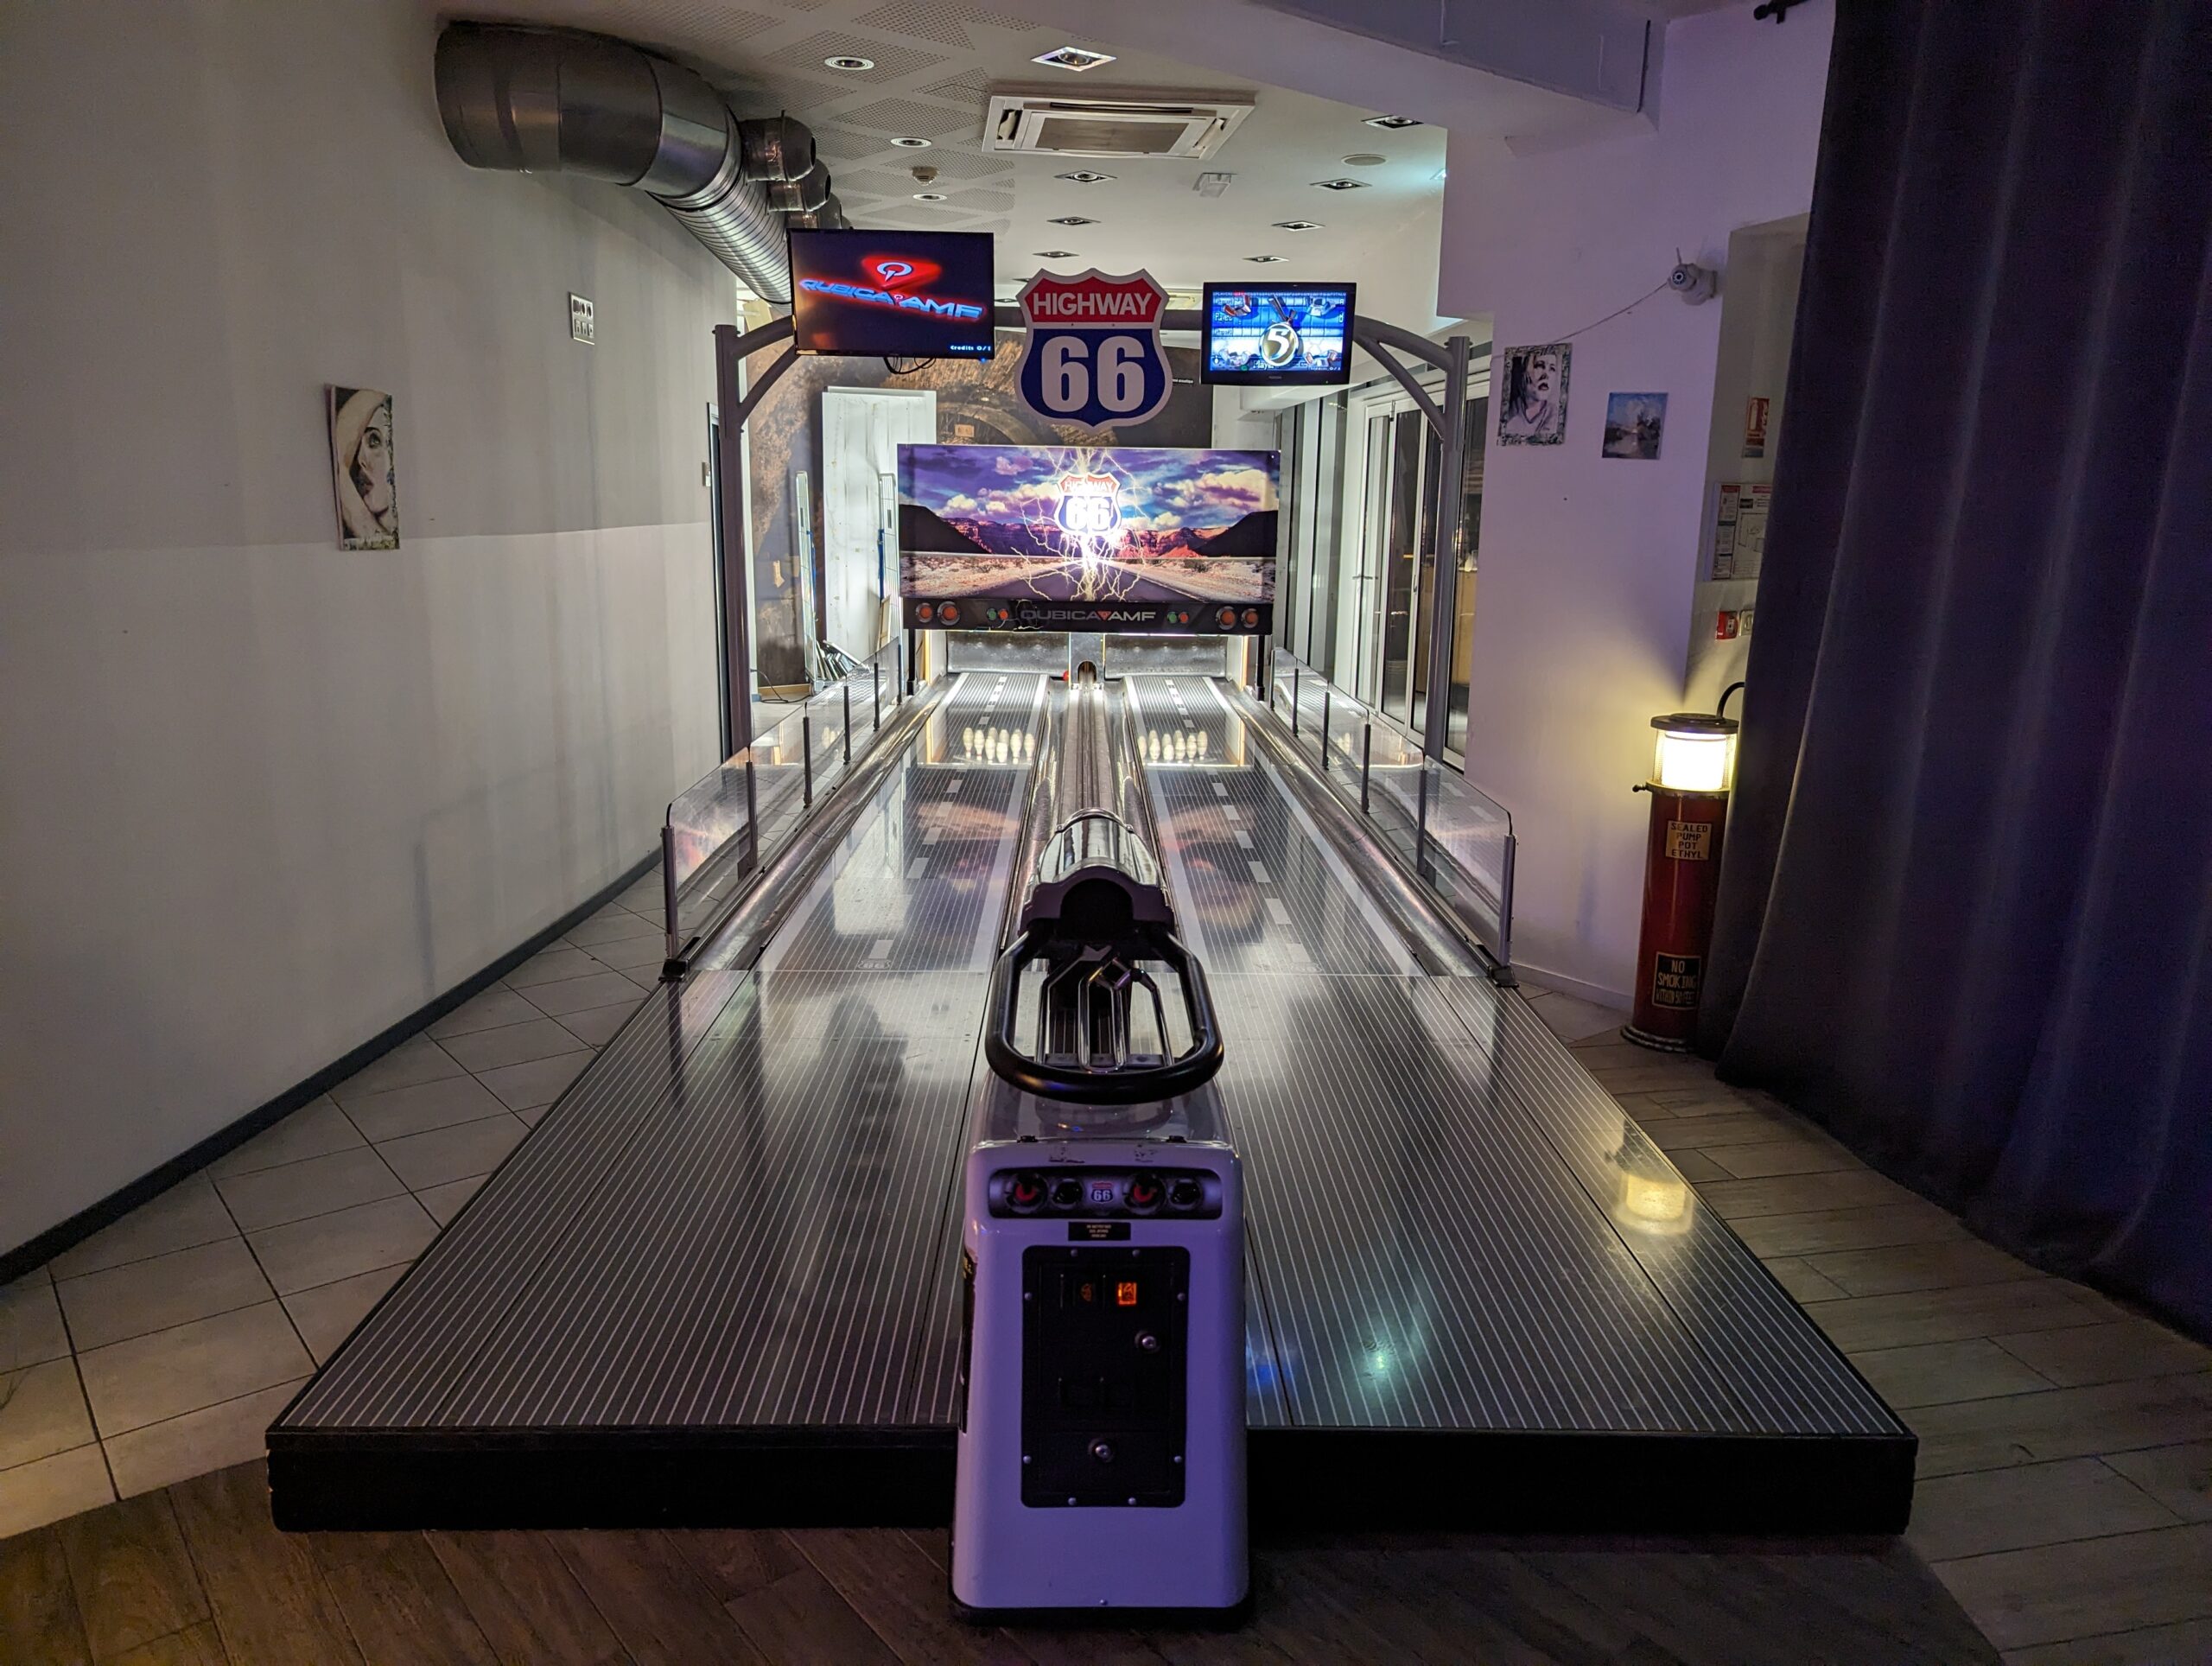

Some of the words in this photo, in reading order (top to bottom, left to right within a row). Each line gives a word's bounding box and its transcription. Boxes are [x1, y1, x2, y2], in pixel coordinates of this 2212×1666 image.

[1033, 292, 1152, 315] HIGHWAY
[1268, 328, 1290, 359] 5
[1041, 335, 1145, 412] 66
[1066, 497, 1110, 531] 66
[1671, 822, 1708, 833] SEALED
[1676, 831, 1701, 842] PUMP
[1678, 841, 1698, 850] POT
[1671, 849, 1703, 859] ETHYL
[1671, 959, 1685, 974] NO
[1657, 971, 1697, 989] SMOKING
[1093, 1189, 1111, 1202] 66
